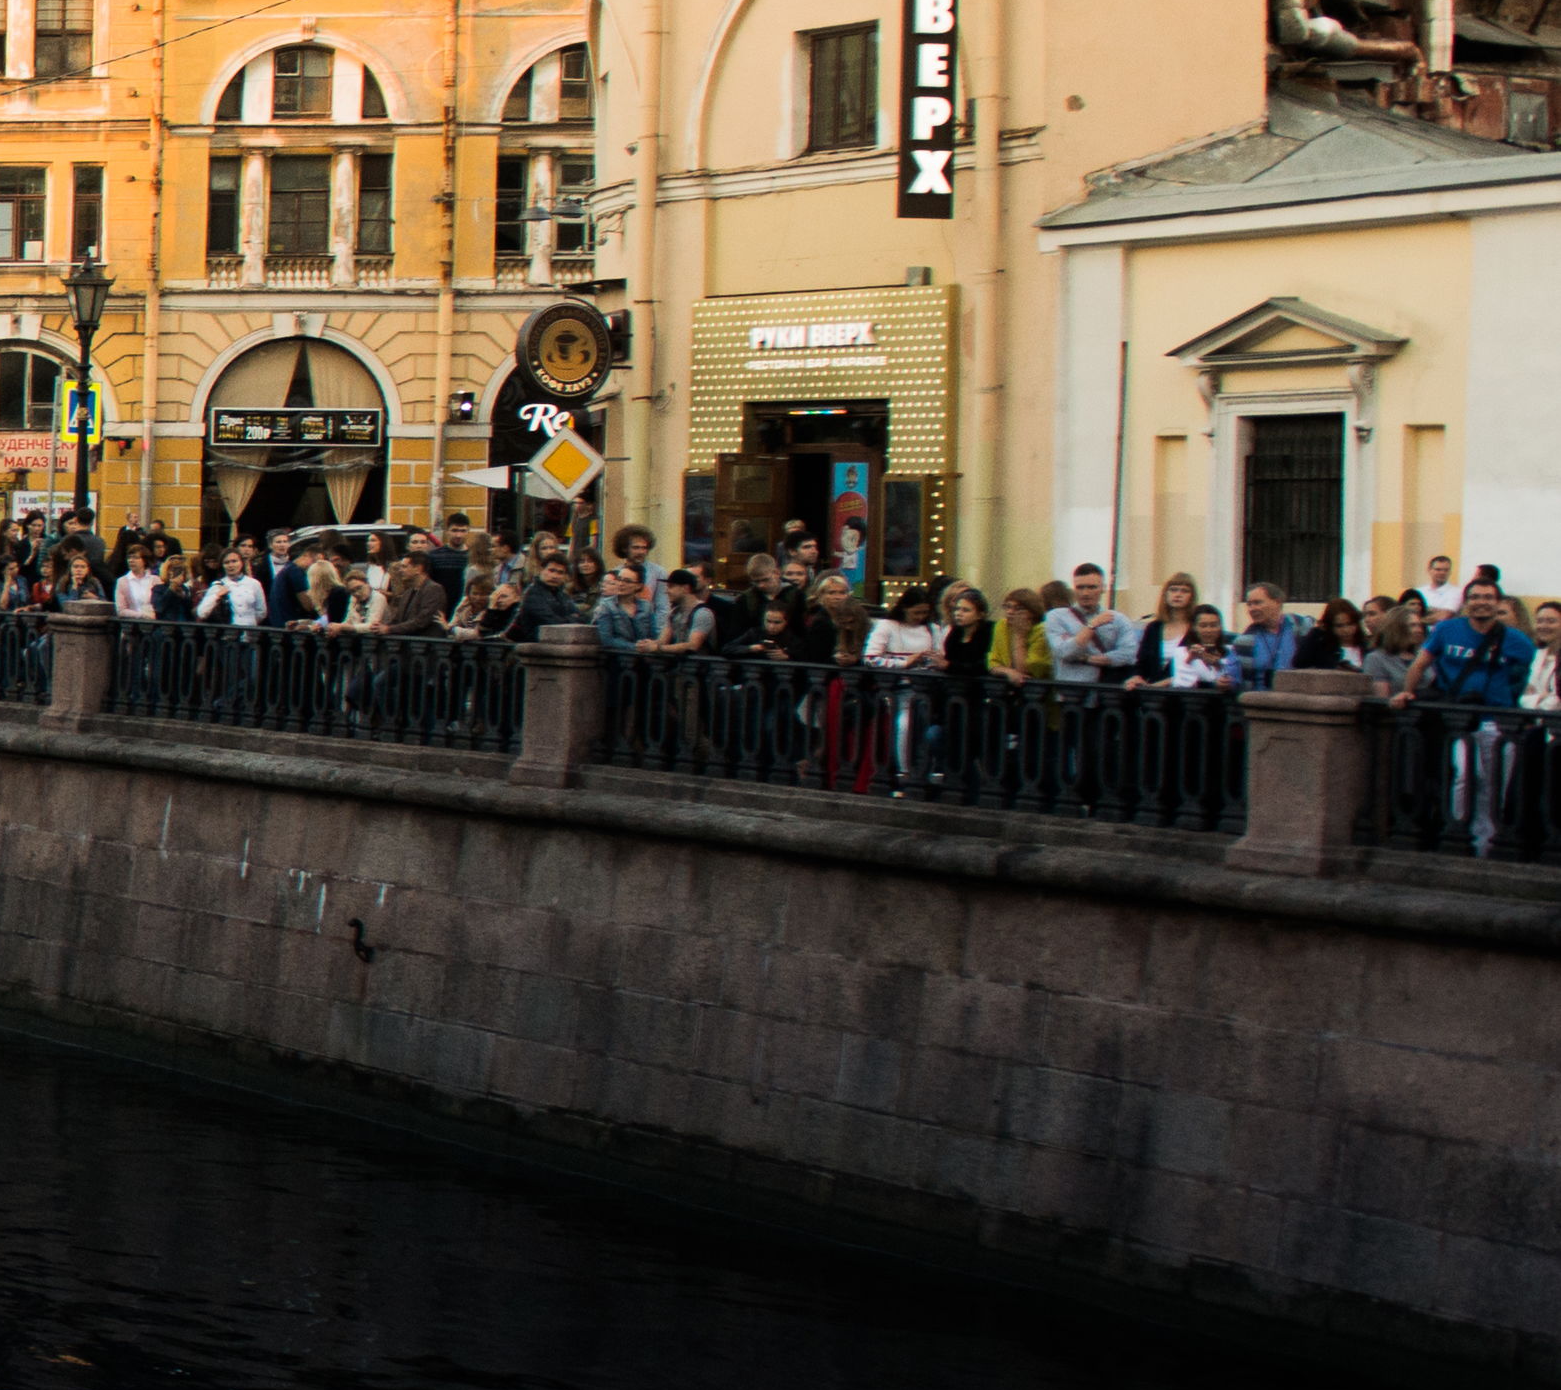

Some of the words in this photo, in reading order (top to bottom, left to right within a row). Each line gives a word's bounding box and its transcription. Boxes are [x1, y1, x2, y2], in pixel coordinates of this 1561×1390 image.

[749, 325, 808, 350] РУКИ
[808, 322, 878, 348] ВВЕРХ
[744, 359, 804, 370] РЕСТОРАН
[804, 357, 830, 368] БАР
[831, 355, 888, 367] КАРАОКЕ
